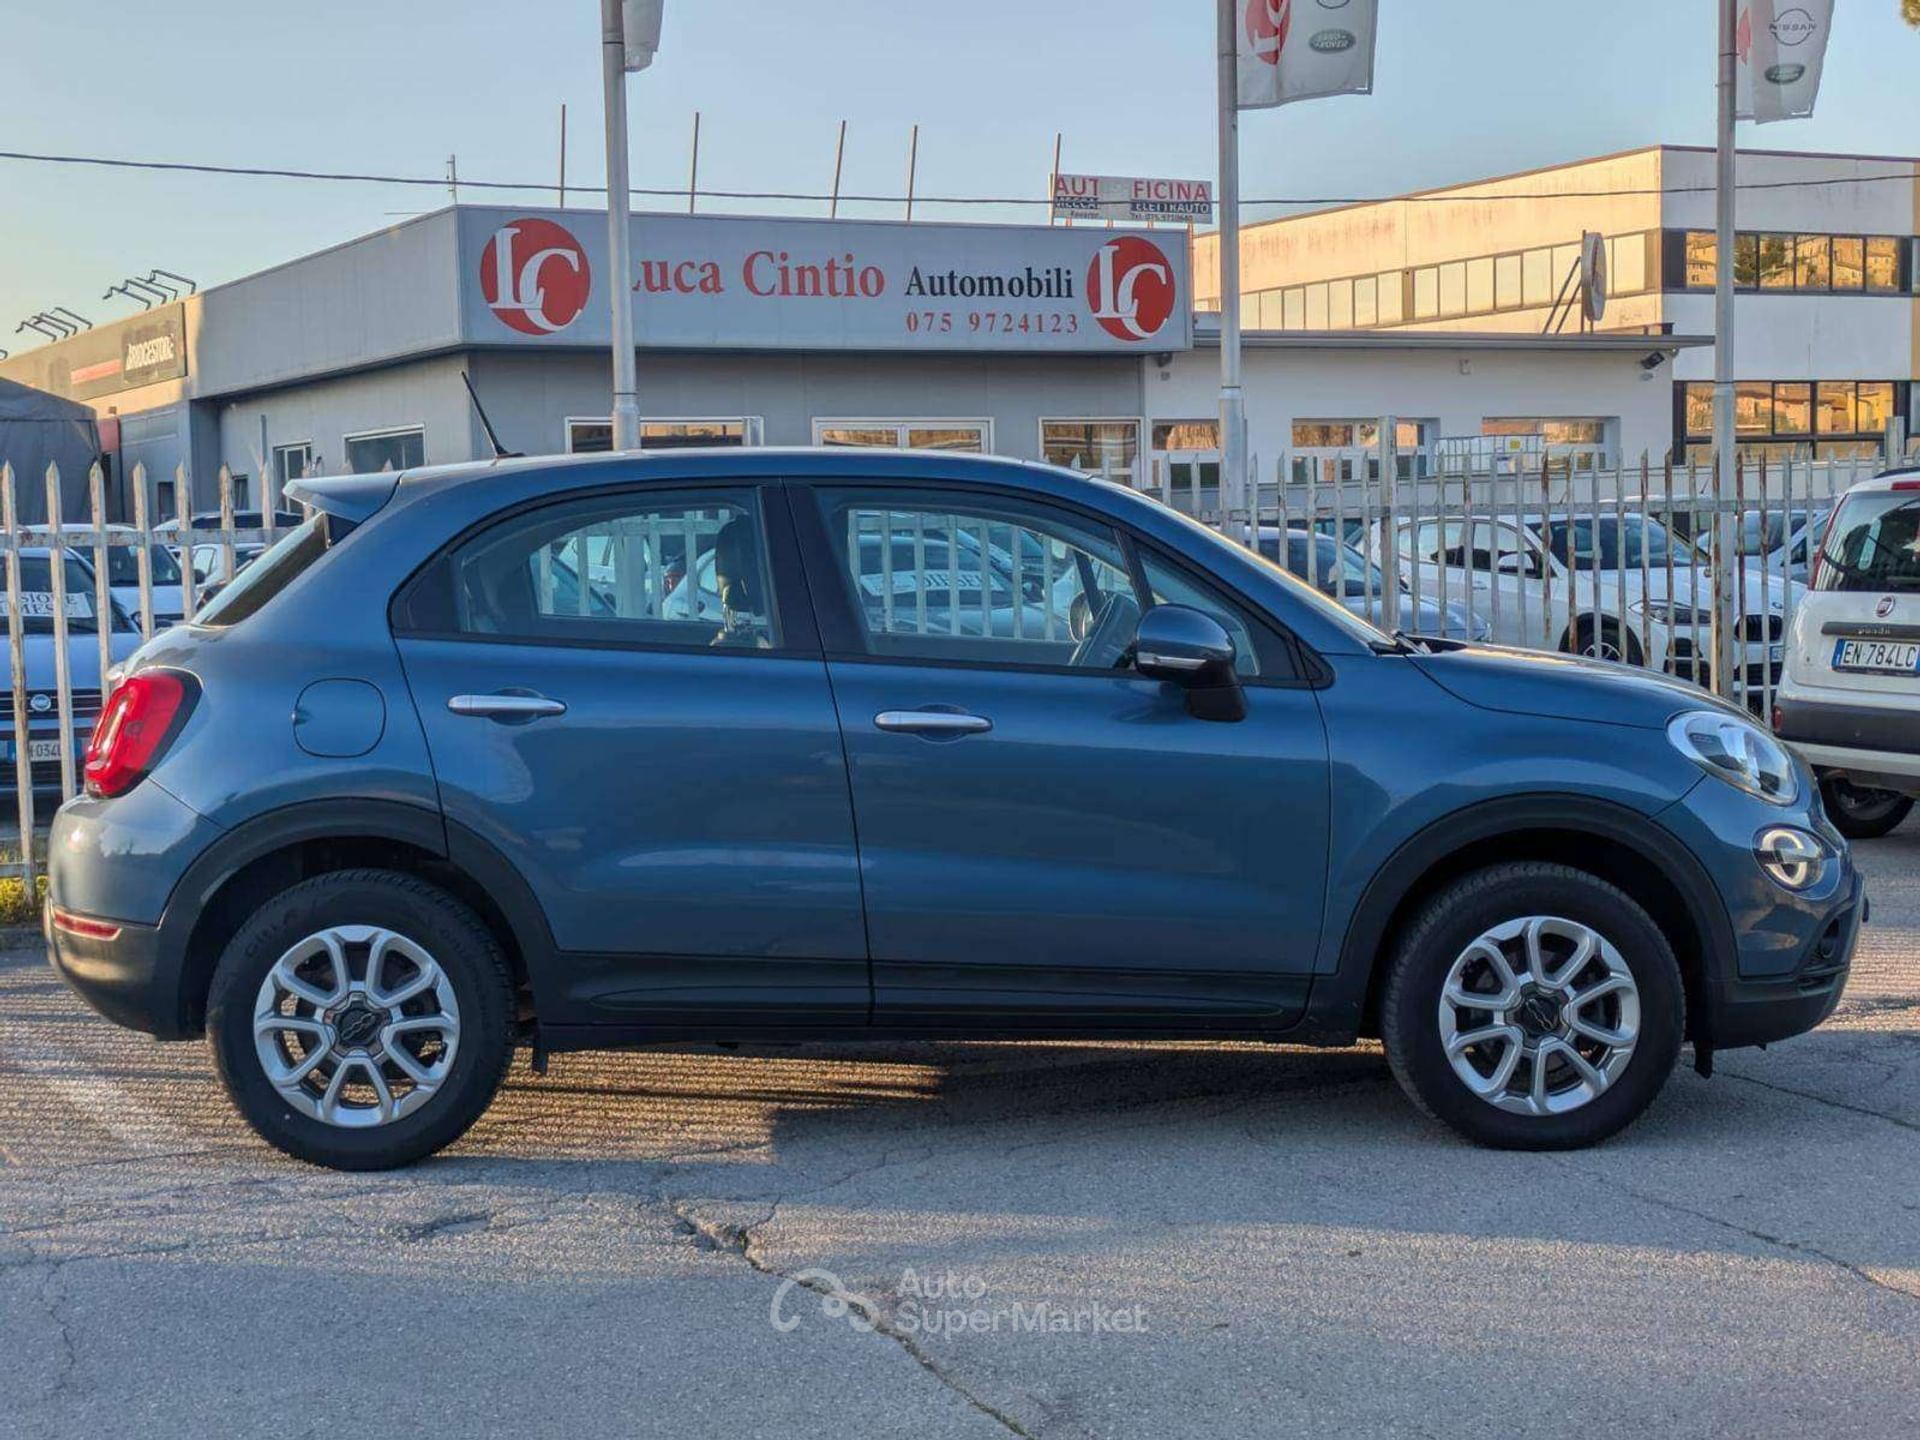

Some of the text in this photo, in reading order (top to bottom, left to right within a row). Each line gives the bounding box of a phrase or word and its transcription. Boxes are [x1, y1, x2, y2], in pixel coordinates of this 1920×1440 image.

[631, 250, 1075, 299] uca Cintio Automobili
[906, 312, 1079, 334] 075 9724123
[1866, 644, 1917, 668] 784LC
